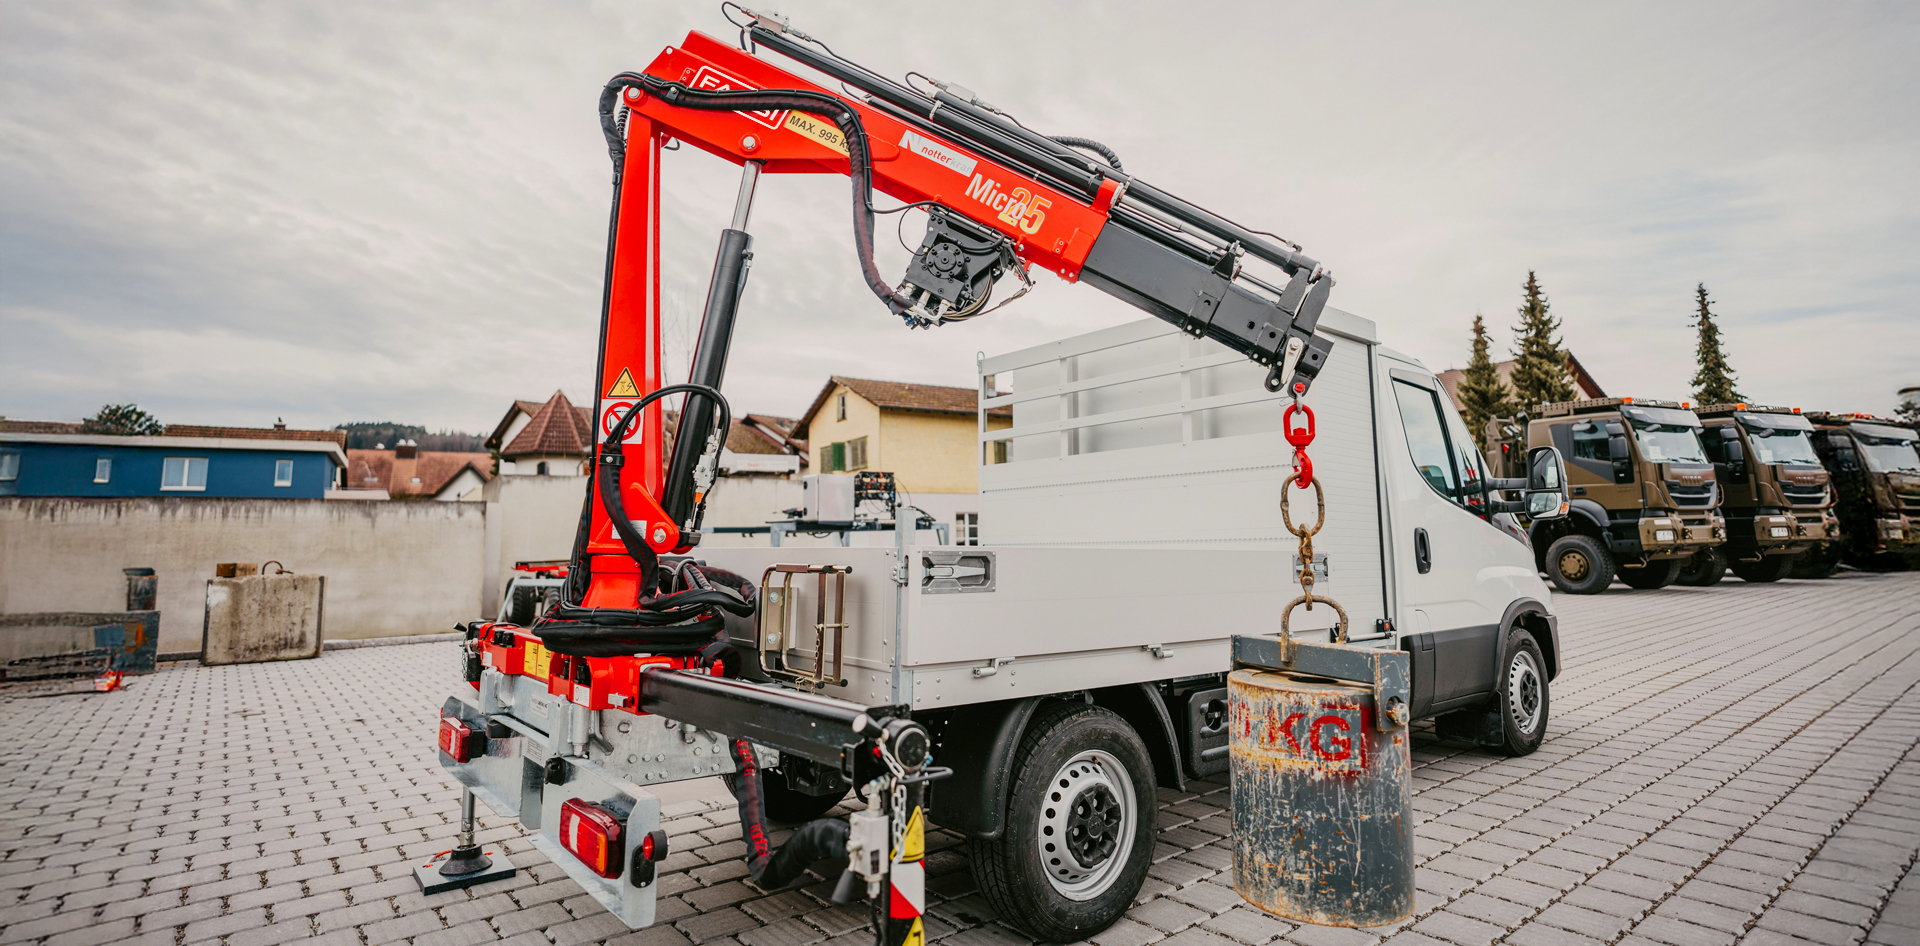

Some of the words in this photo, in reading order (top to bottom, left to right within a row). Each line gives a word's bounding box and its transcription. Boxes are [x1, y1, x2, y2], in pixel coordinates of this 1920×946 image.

[789, 115, 816, 135] MAX.
[818, 129, 839, 144] 995
[921, 146, 973, 174] notterkran
[965, 172, 1027, 219] Micro
[997, 187, 1053, 235] 25
[1268, 708, 1352, 762] KG
